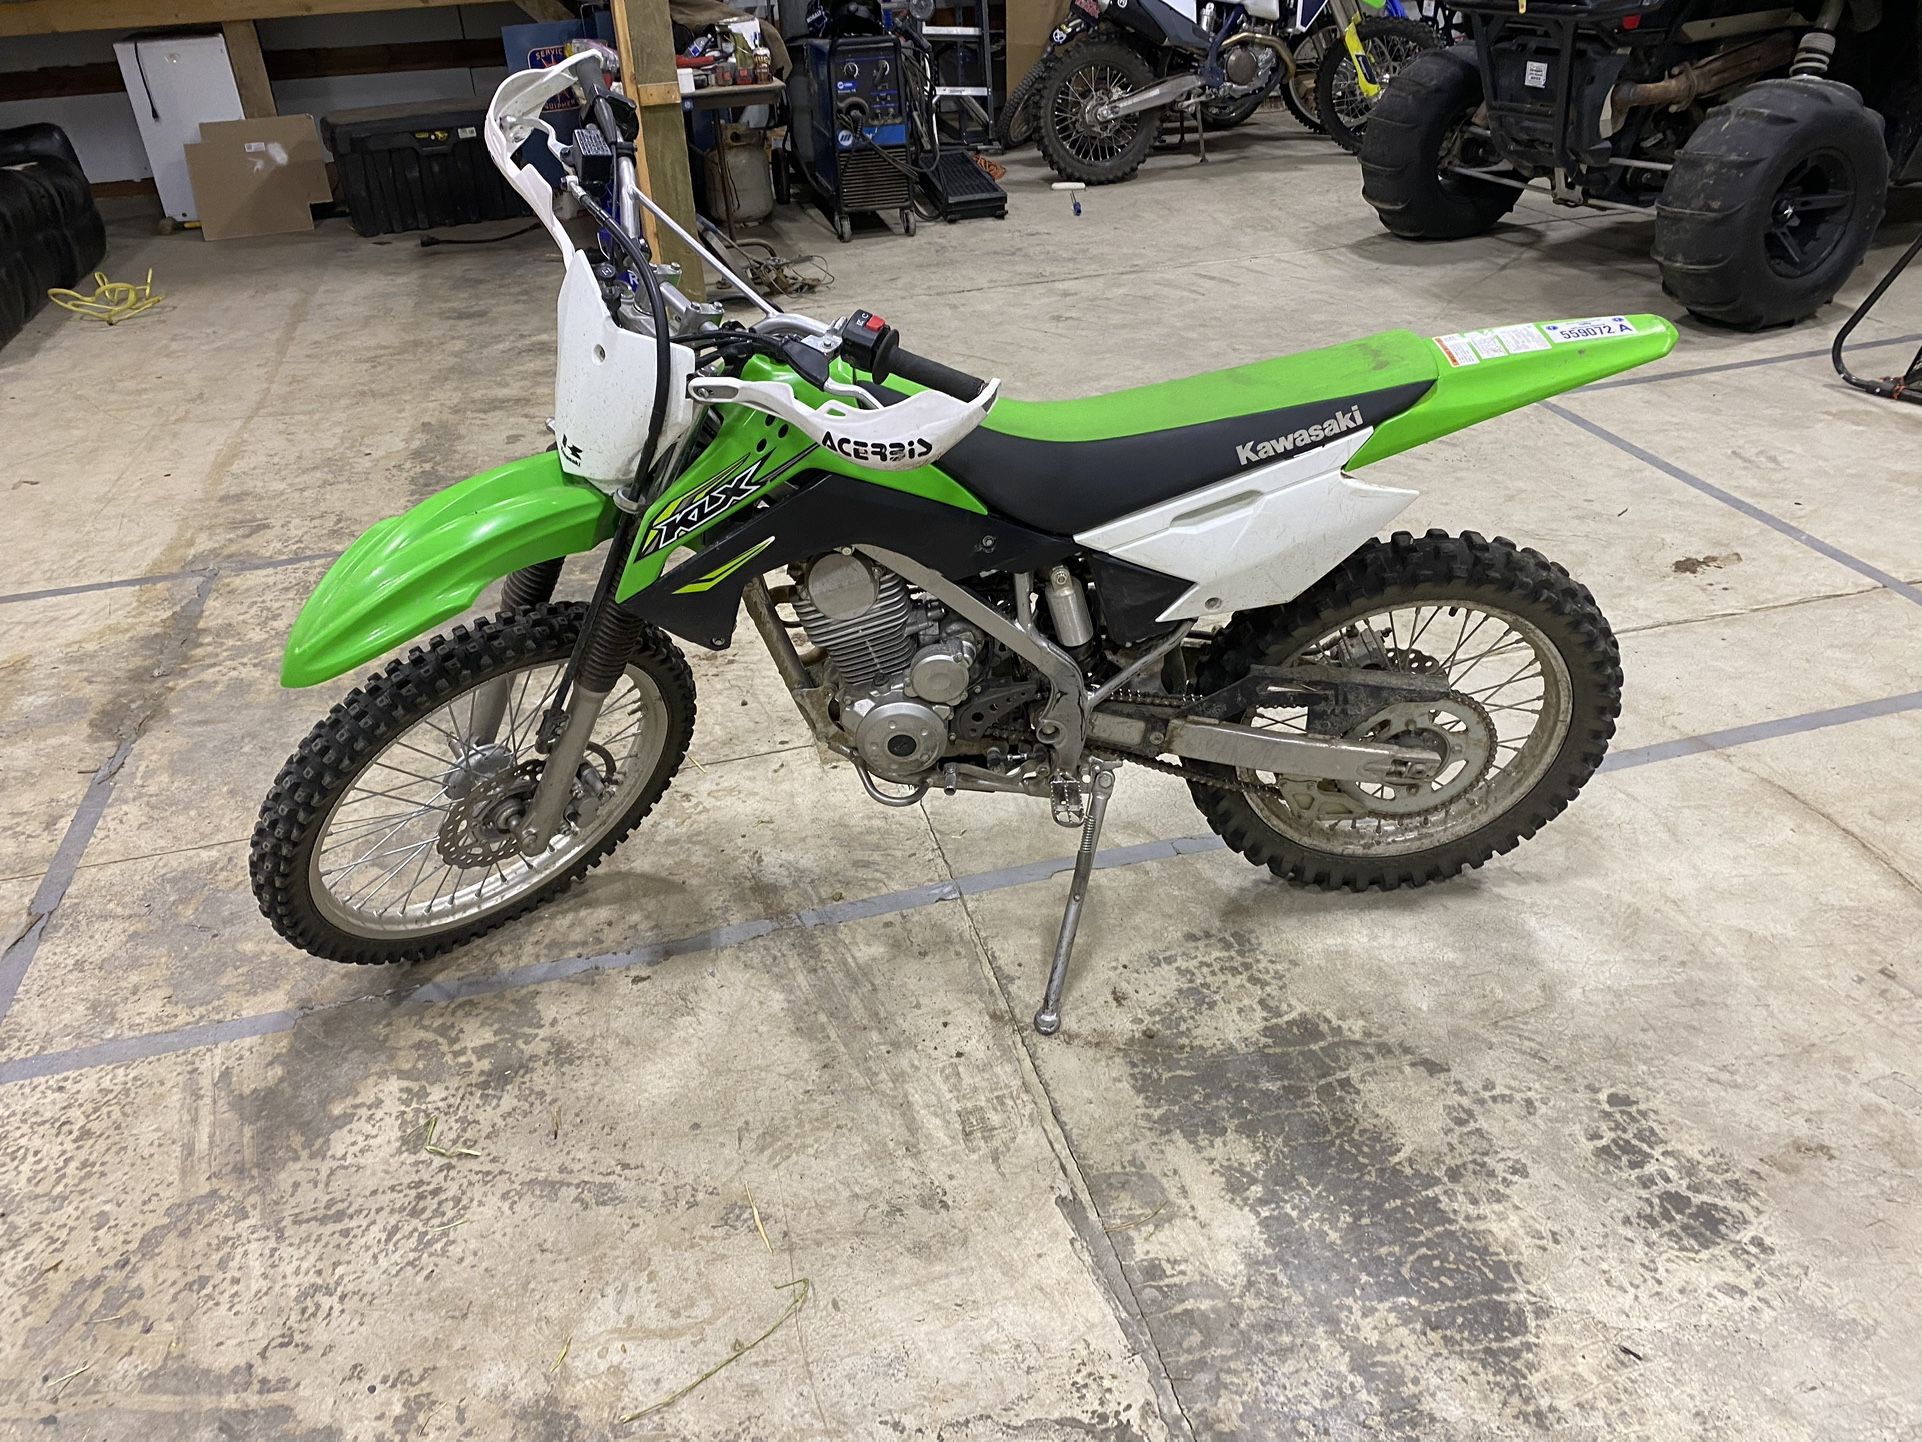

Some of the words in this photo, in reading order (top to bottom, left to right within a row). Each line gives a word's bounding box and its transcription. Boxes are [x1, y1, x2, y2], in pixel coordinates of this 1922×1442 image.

[535, 47, 564, 60] SERVIC
[1560, 325, 1615, 339] 559072
[1619, 323, 1633, 333] A
[1235, 404, 1364, 466] Kawasaki
[653, 460, 761, 549] KLX
